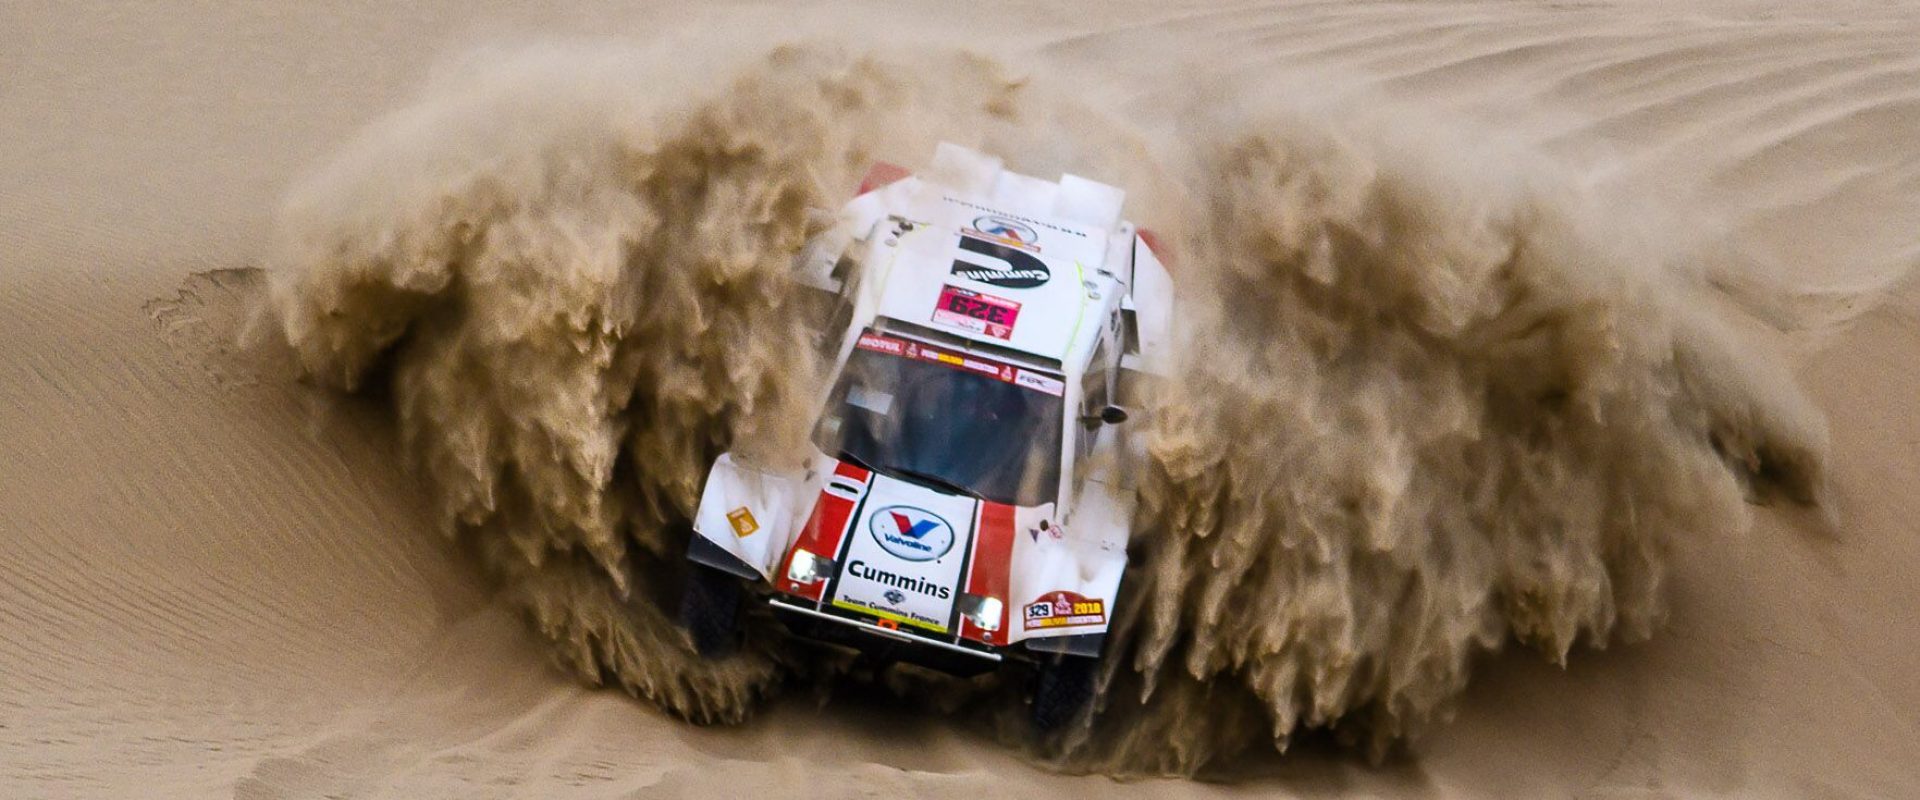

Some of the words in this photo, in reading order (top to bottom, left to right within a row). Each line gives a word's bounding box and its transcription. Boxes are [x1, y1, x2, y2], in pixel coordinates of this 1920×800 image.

[948, 295, 1009, 325] 329
[859, 337, 900, 351] MOTUL
[885, 533, 932, 551] Valvoline
[848, 560, 950, 599] Cummins
[844, 595, 866, 608] Team
[869, 602, 908, 617] Cummins
[910, 612, 940, 624] France
[1029, 604, 1048, 617] 329
[1074, 602, 1101, 614] 2018
